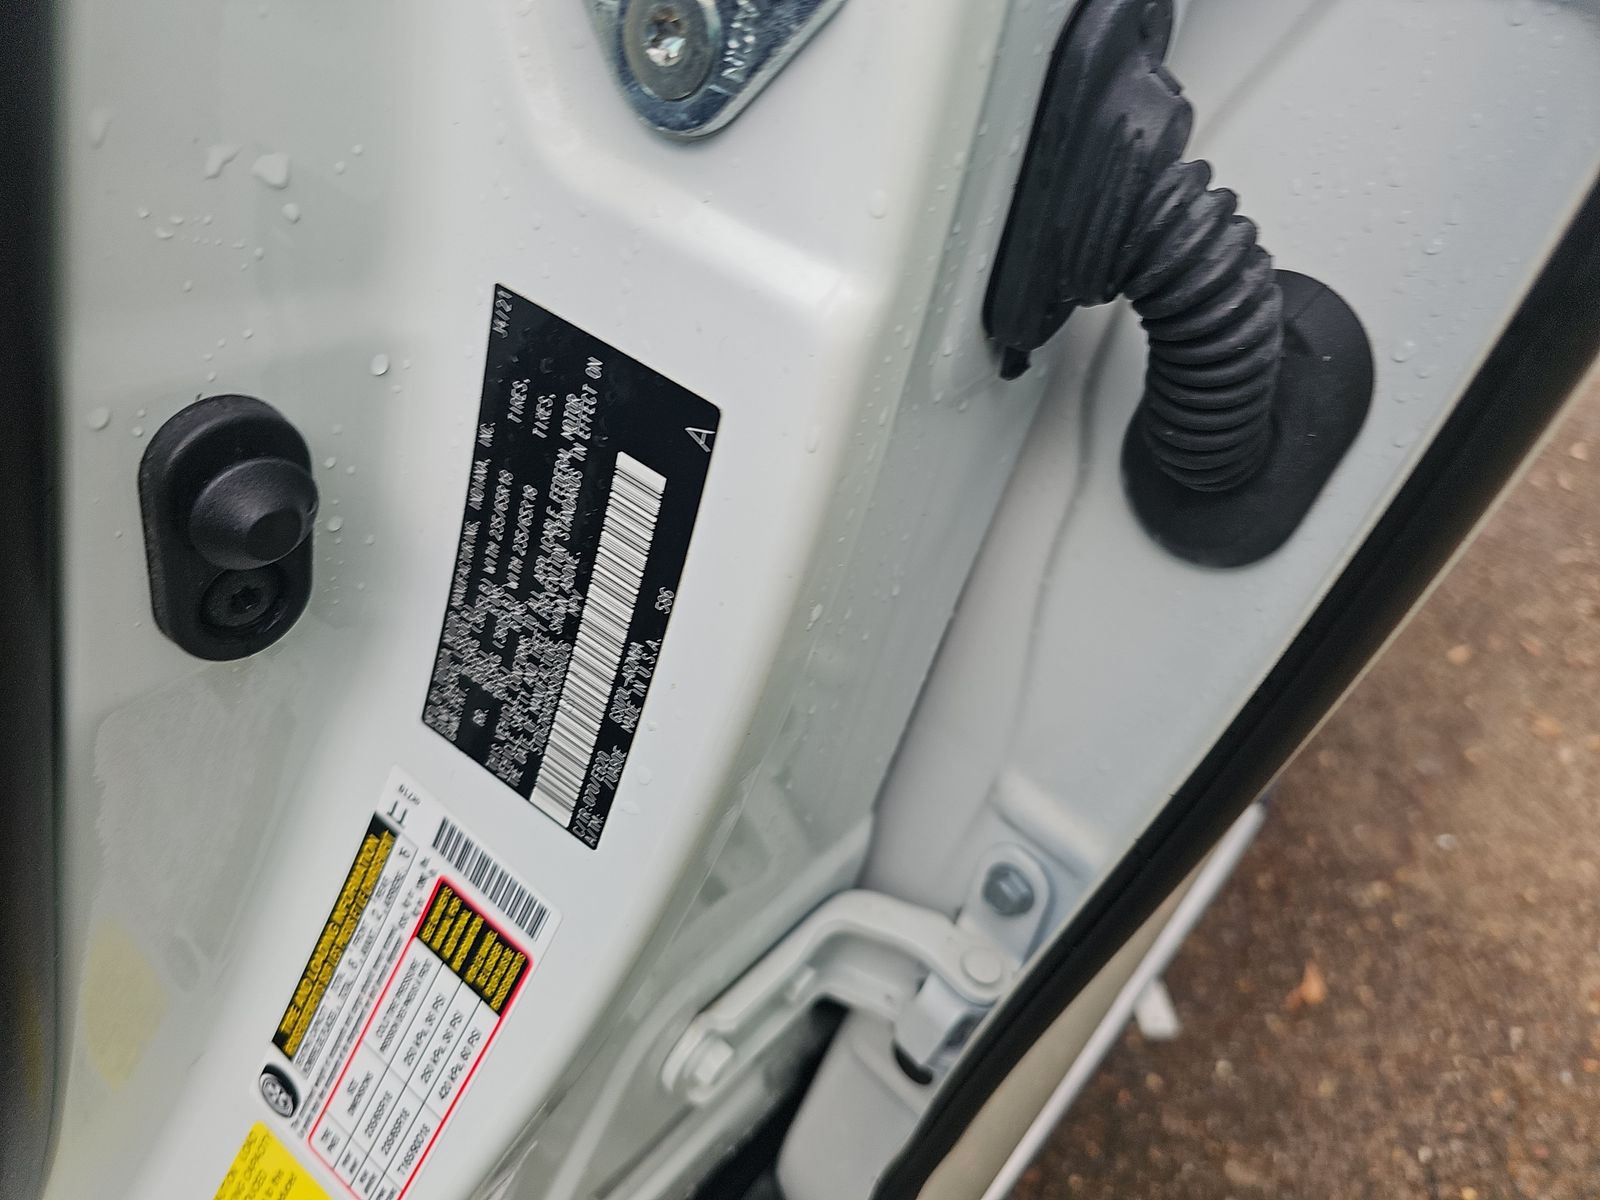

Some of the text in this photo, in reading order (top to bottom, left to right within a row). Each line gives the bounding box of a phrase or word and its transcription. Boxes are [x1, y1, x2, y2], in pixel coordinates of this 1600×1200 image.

[585, 357, 602, 379] ON
[508, 379, 529, 422] TIRES,
[532, 394, 555, 438] TIRES,
[573, 384, 597, 439] EFFECT
[478, 423, 495, 447] INC.
[685, 427, 714, 452] A
[469, 459, 490, 509] INDIANA,
[489, 470, 512, 540] 235/65R18
[554, 468, 582, 540] STANDARDS
[513, 485, 537, 555] 235/65R18
[452, 521, 479, 612] MANUFACTURING,
[483, 541, 499, 574] WITH
[505, 556, 522, 589] WITH
[558, 551, 580, 593] ABOVE.
[485, 743, 502, 770] THIS
[495, 693, 515, 740] VEHICLE
[507, 630, 531, 691] CONFORMS
[534, 507, 562, 586] APPLICABLE
[549, 449, 572, 503] FEDERAL
[561, 394, 582, 440] MOTOR
[538, 543, 566, 619] PREVENTION
[549, 595, 570, 634] SHOWN
[567, 589, 583, 617] MPV
[528, 621, 547, 660] THEFT
[522, 662, 538, 687] AND
[528, 637, 558, 716] MANUFACTURE
[510, 688, 530, 730] SAFETY
[585, 809, 603, 845] A/TM:
[621, 698, 641, 733] MADE
[636, 639, 661, 678] U.S.A.
[655, 587, 674, 614] 586
[497, 731, 517, 781] VEHICLE
[513, 730, 532, 764] DATE
[507, 762, 523, 786] THE
[280, 836, 378, 1034] TIRE AND LOADING INFORMATION
[371, 908, 383, 921] 2
[438, 1081, 452, 1100] 420
